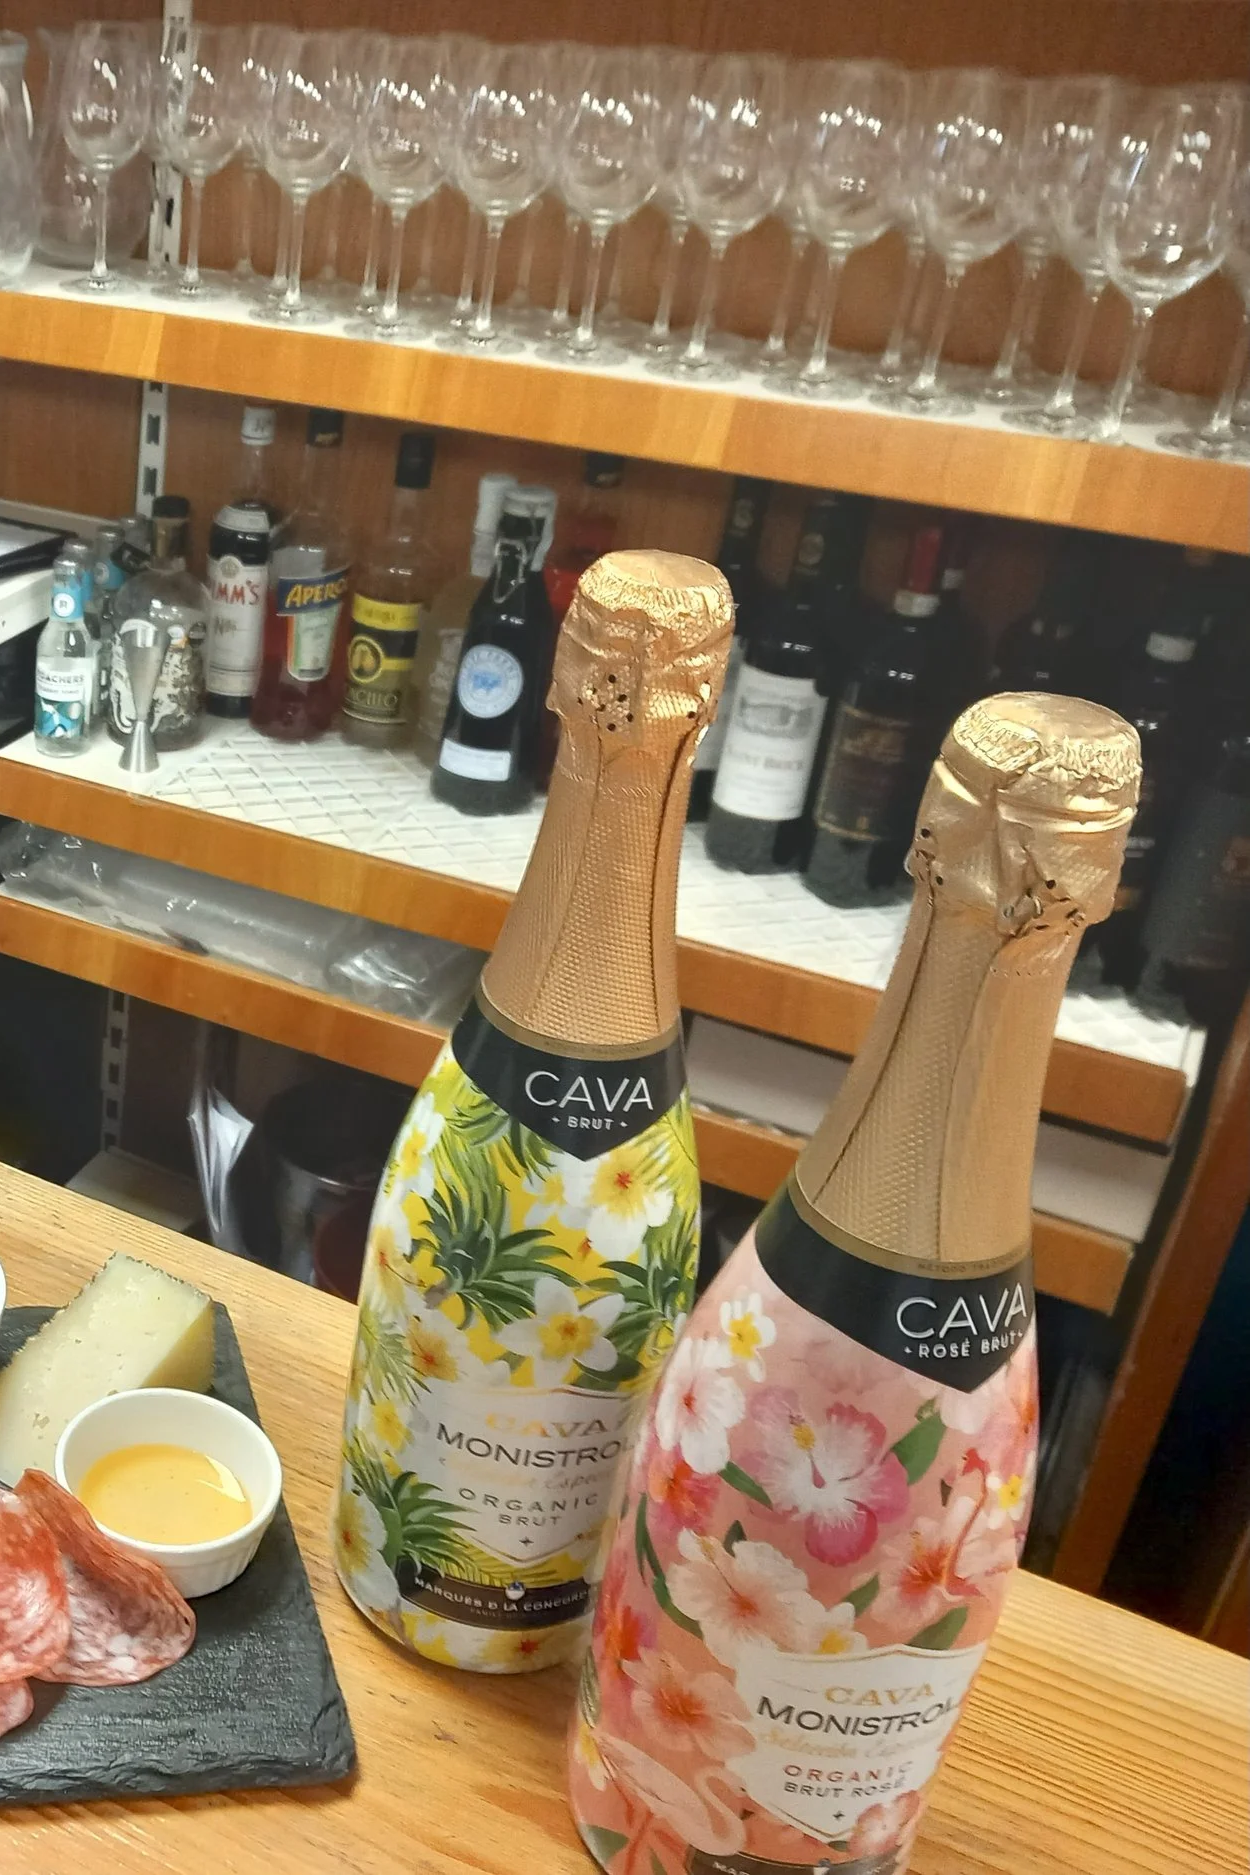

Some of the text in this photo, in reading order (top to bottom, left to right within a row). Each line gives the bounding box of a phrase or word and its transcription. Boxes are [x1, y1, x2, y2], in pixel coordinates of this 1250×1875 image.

[525, 1070, 654, 1113] CAVA
[567, 1116, 615, 1131] BRUT
[896, 1282, 1027, 1340] CAVA
[918, 1332, 1016, 1359] ROSÉ BRUT
[486, 1413, 609, 1439] CAVA
[458, 1487, 599, 1513] ORGANIC
[499, 1514, 562, 1527] BRUT
[824, 1682, 935, 1706] CAVA
[782, 1760, 913, 1783] ORGANIC
[784, 1781, 845, 1798] BRUT
